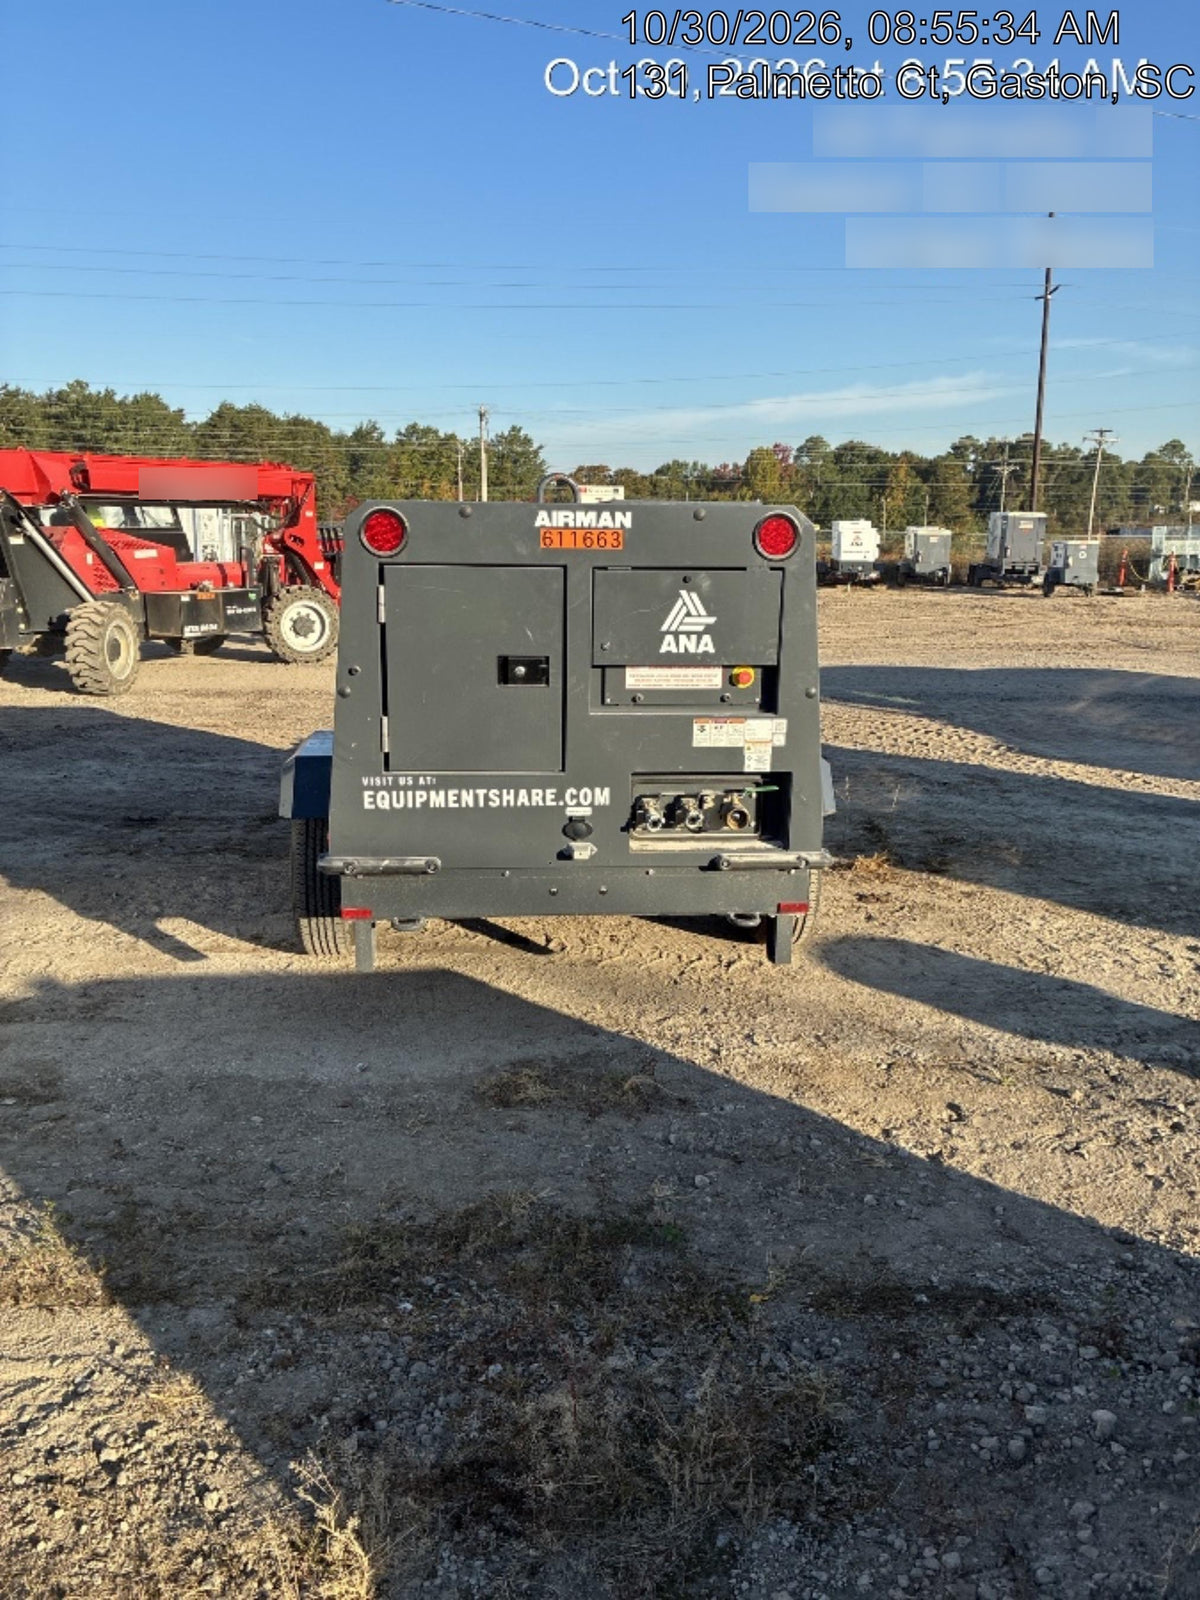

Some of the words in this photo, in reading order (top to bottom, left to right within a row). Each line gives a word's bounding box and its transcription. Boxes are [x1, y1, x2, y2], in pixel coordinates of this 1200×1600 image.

[534, 509, 632, 529] AIRMAN
[541, 530, 622, 549] 611663
[659, 634, 716, 654] ANA
[362, 776, 394, 787] VISIT
[398, 776, 413, 786] US
[418, 776, 437, 786] AT:
[362, 787, 612, 810] EQUIPMENTSHARE.COM
